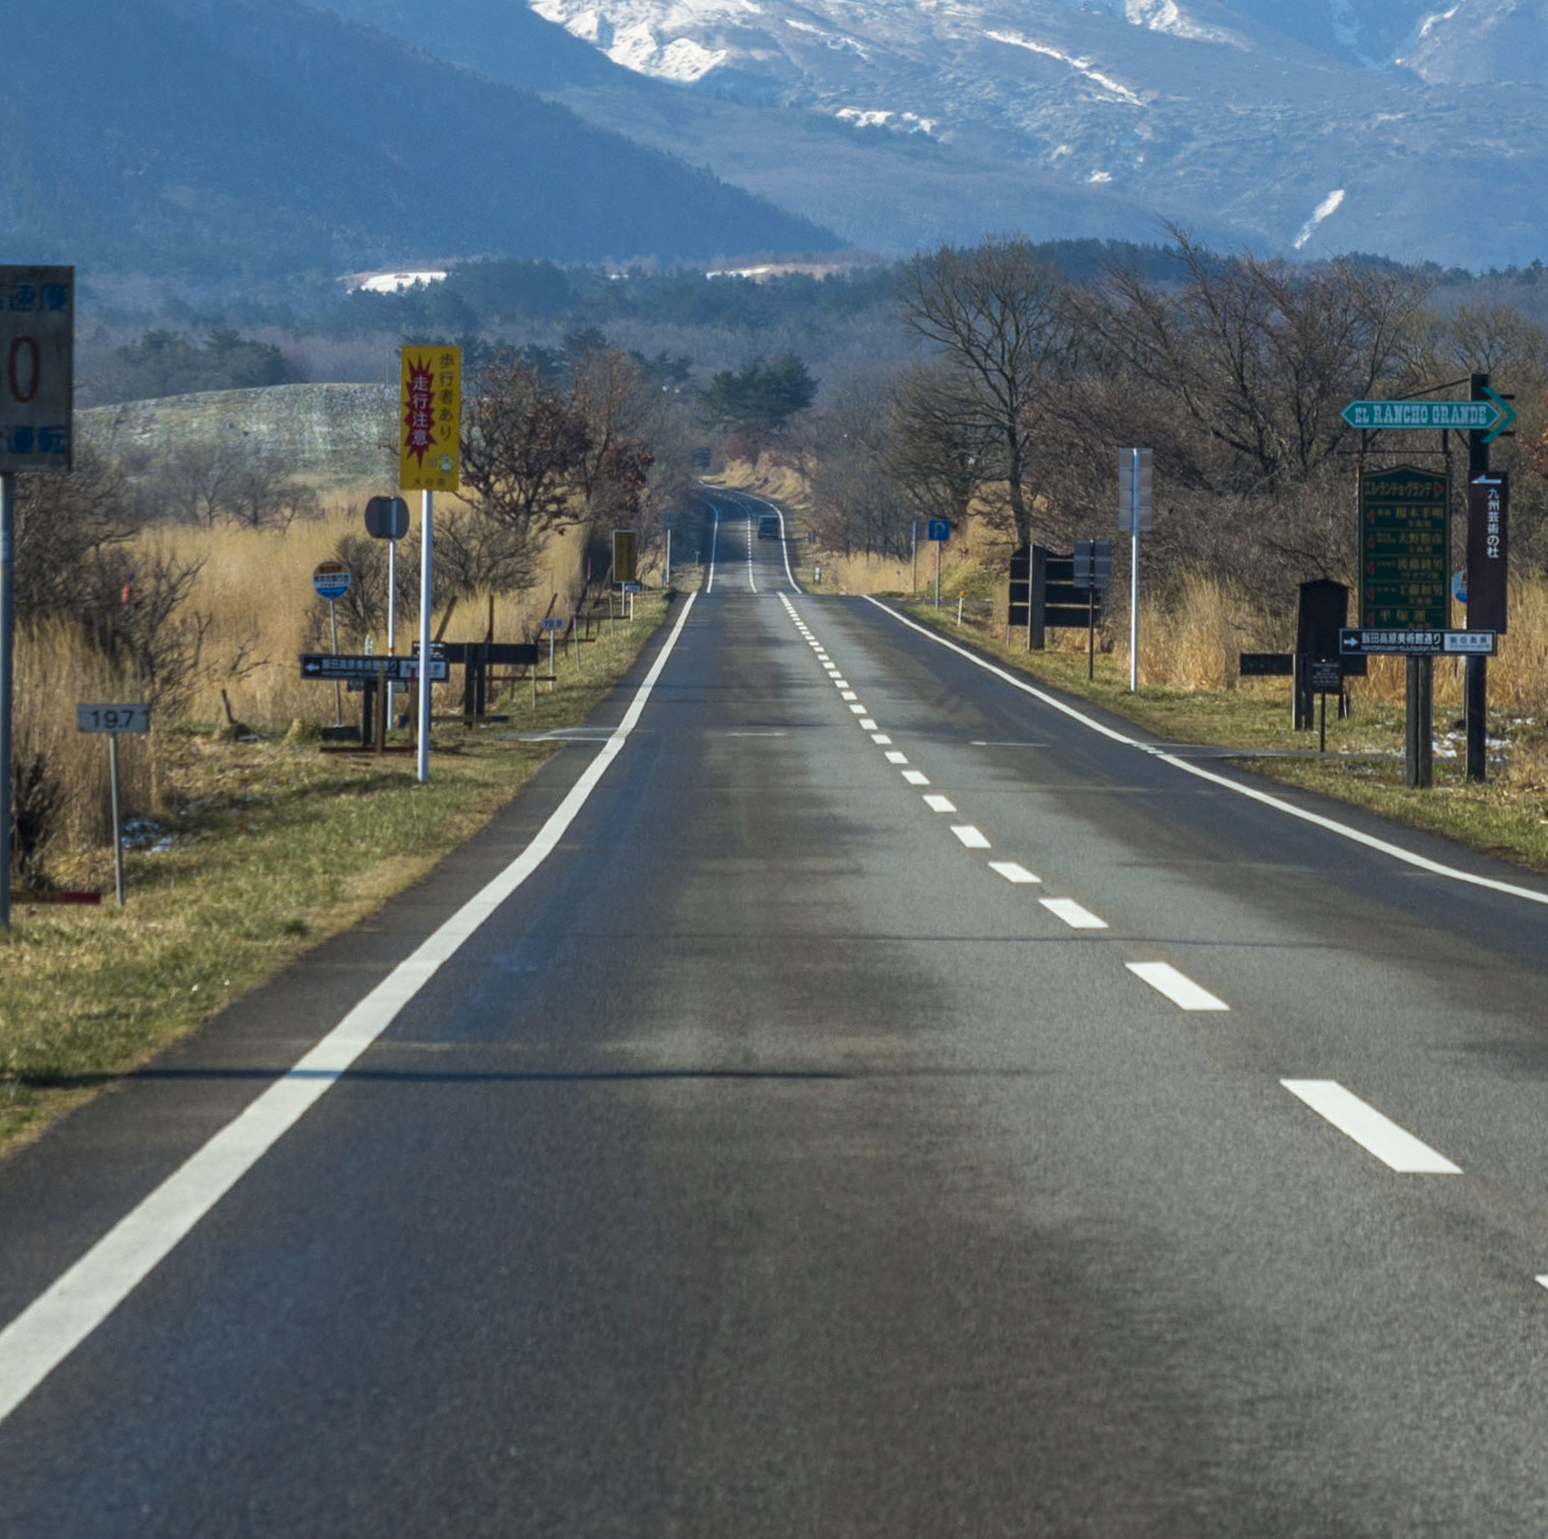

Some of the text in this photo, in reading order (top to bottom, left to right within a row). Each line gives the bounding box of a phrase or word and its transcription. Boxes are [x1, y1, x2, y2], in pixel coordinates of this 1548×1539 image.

[412, 374, 429, 446] 走行注意
[439, 352, 454, 441] 歩行者あり
[1354, 404, 1487, 425] EL RANCHO GRANDE
[1486, 487, 1501, 559] 九州芸術の杜
[90, 709, 135, 730] 19.7
